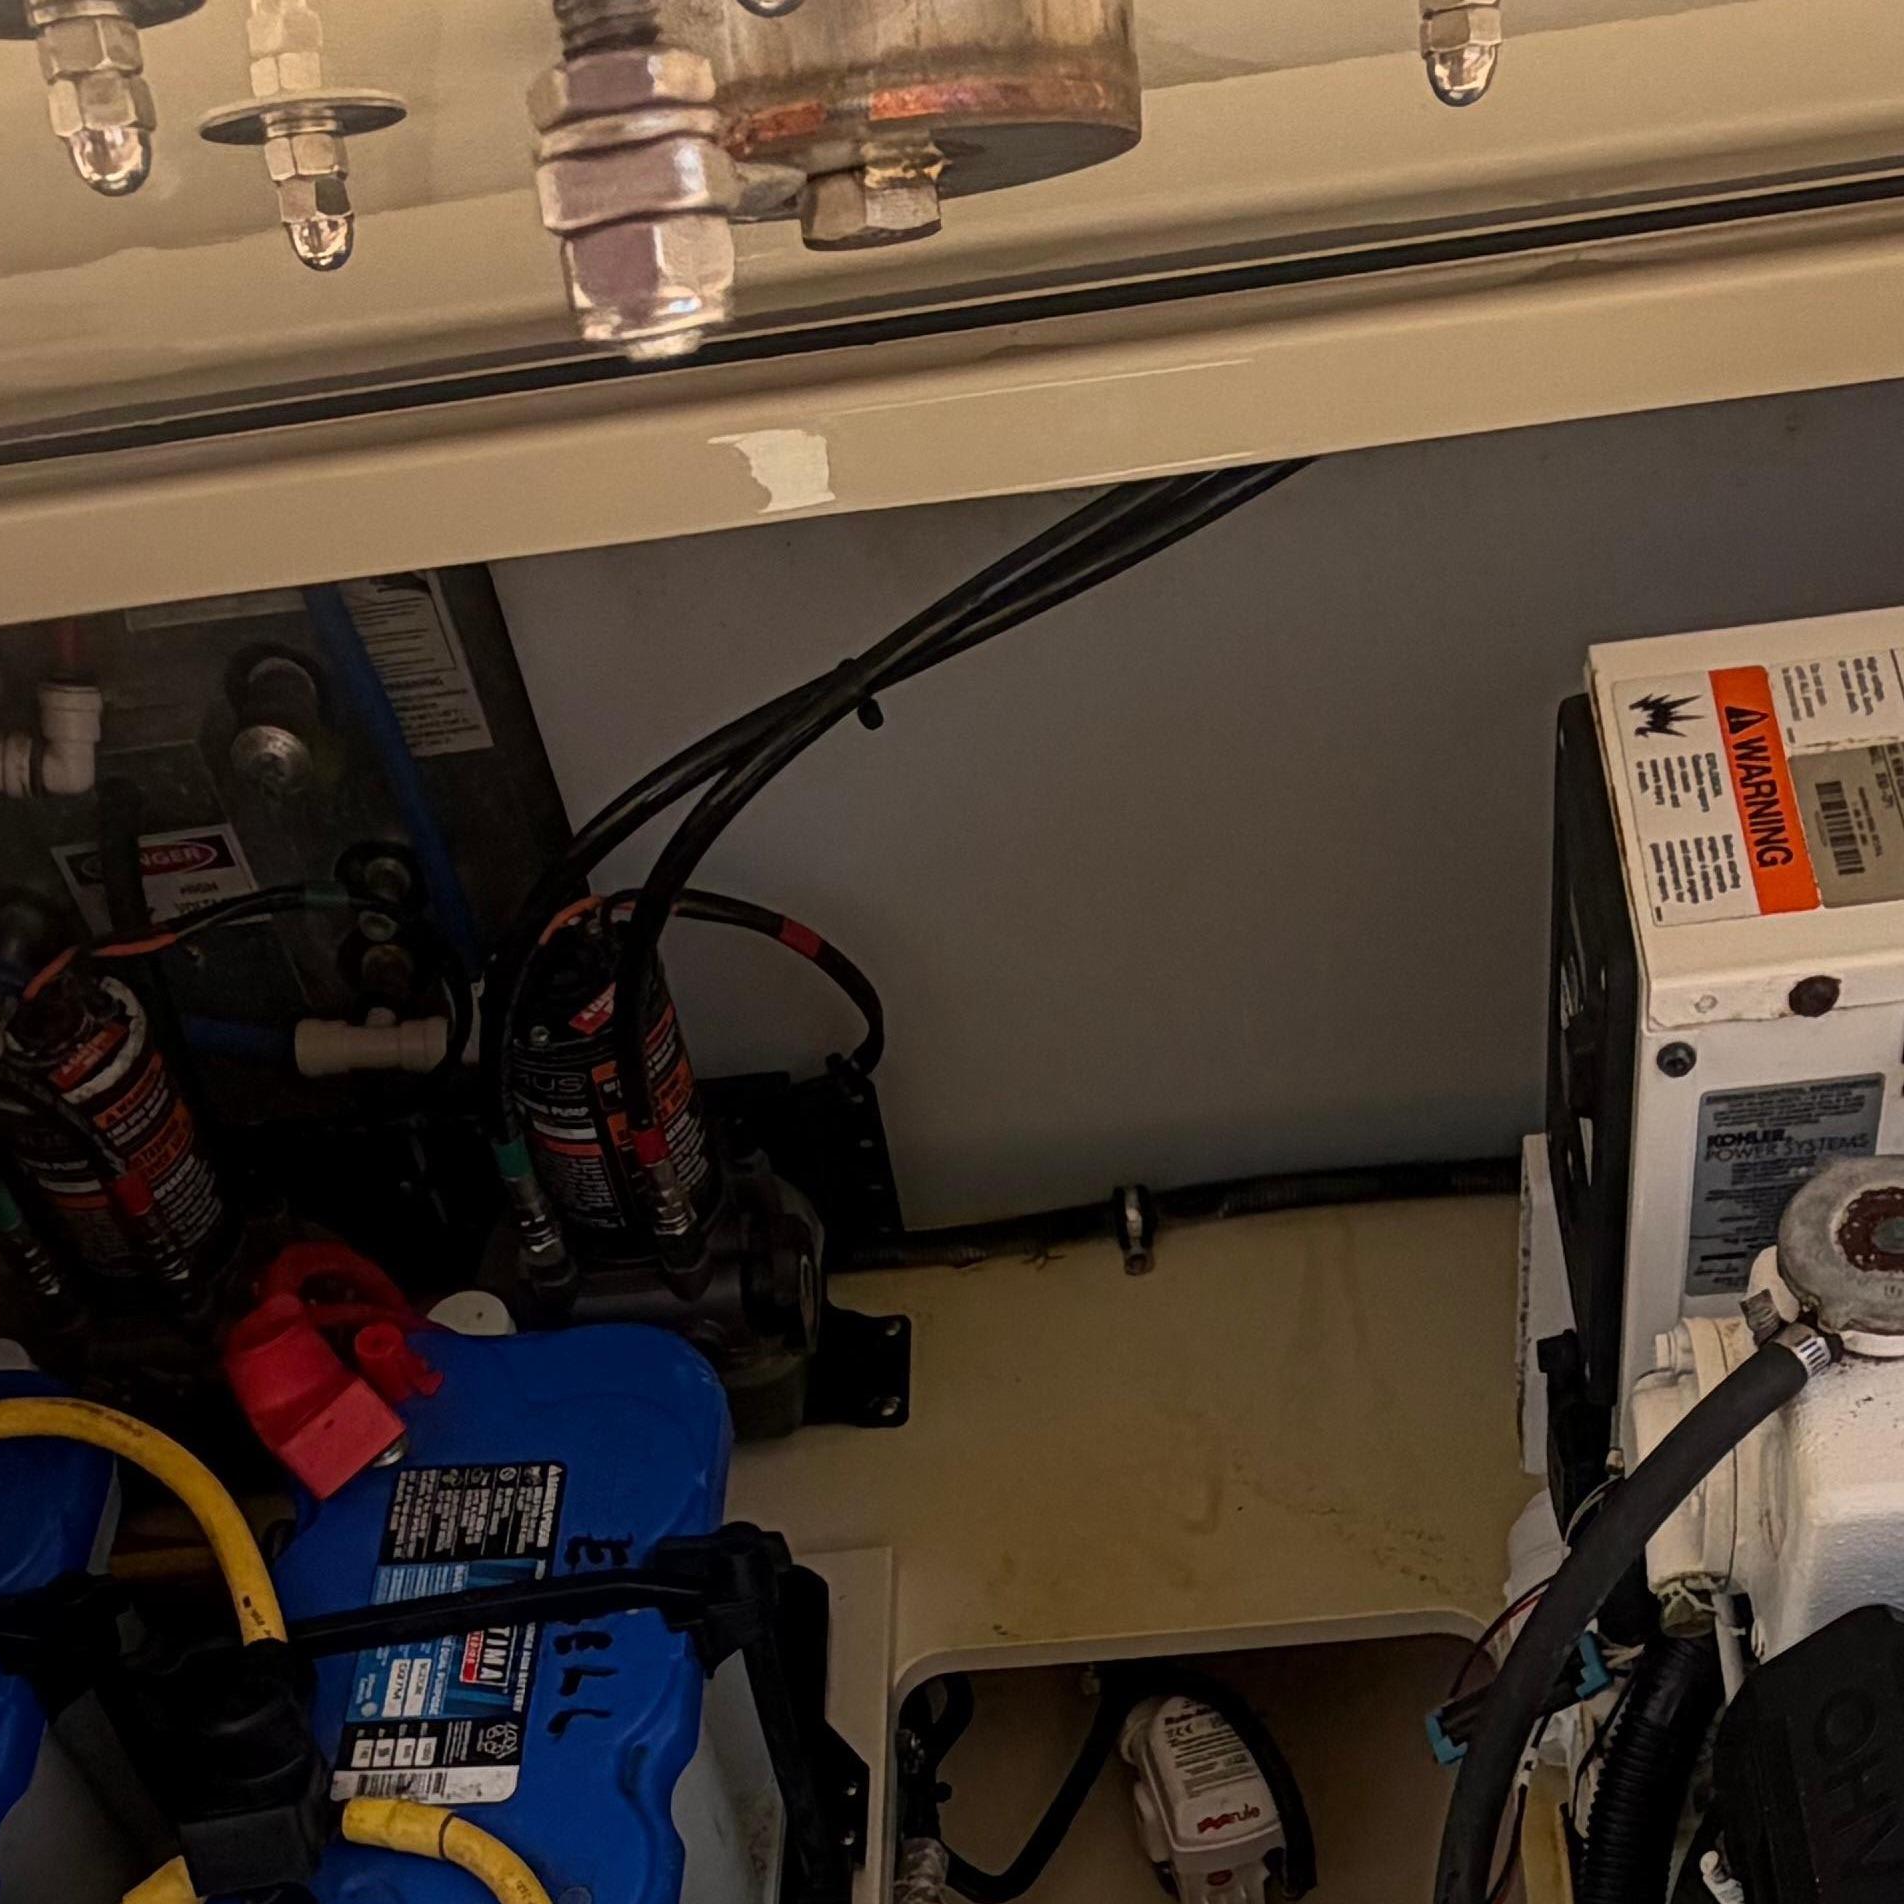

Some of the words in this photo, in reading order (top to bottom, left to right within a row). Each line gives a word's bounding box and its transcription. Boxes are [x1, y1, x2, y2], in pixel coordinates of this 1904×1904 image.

[1730, 735, 1794, 870] WARNING
[1706, 1125, 1785, 1152] KOHLER
[478, 1625, 511, 1680] TIMA
